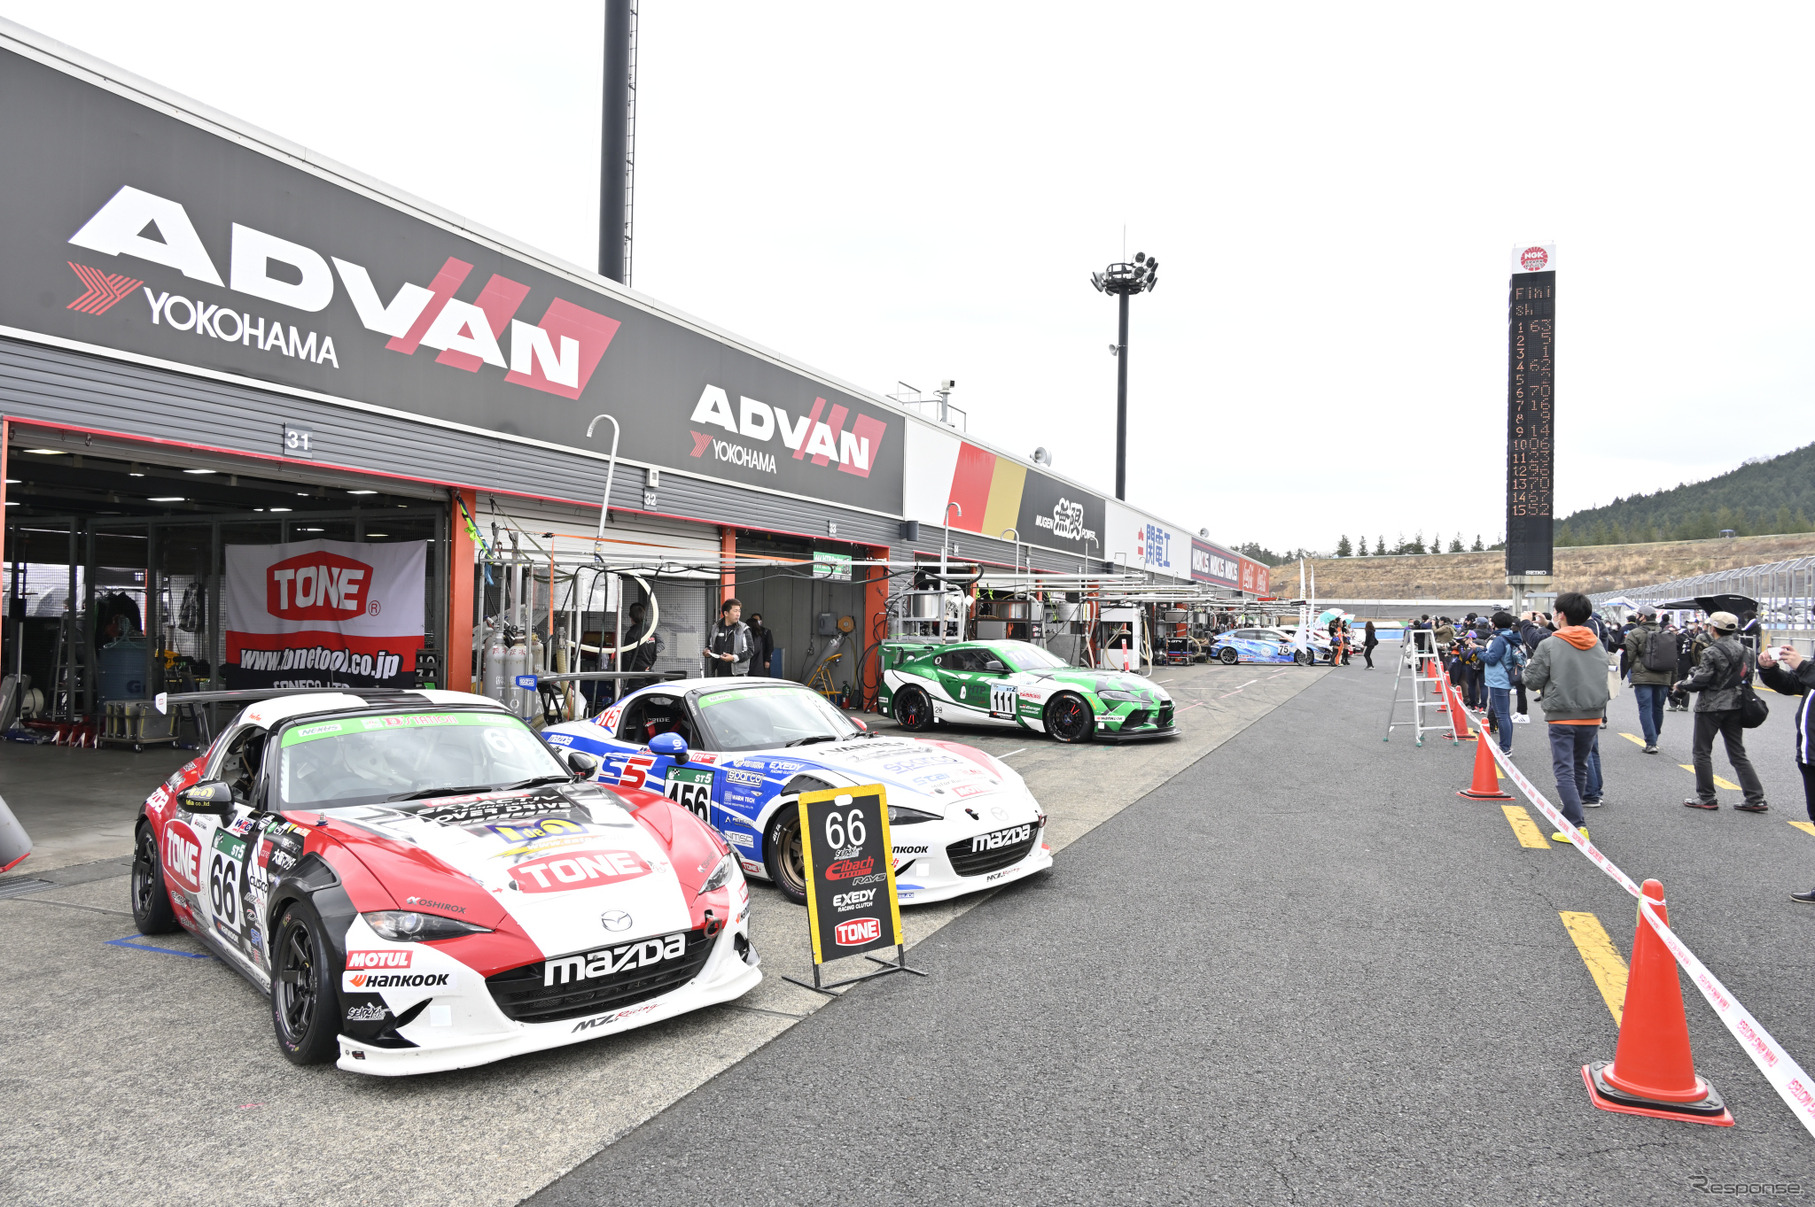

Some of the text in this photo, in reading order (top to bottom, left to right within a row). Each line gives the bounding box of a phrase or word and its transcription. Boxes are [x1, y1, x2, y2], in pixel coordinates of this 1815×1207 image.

[1525, 251, 1543, 259] NGK
[68, 185, 579, 389] ADVAN
[144, 286, 339, 369] YOKOHAMA
[1518, 322, 1524, 333] 1
[1516, 335, 1525, 346] 2
[1516, 348, 1525, 359] 3
[1516, 361, 1524, 372] 4
[1516, 374, 1524, 385] 5
[1516, 388, 1524, 398] 6
[1516, 400, 1524, 411] 7
[1516, 414, 1524, 424] 8
[690, 383, 869, 471] ADVAN
[1516, 426, 1524, 437] 9
[286, 429, 311, 451] 31
[1513, 440, 1527, 450] 10
[712, 437, 777, 475] YOKOHAMA
[1513, 452, 1526, 463] 11
[1513, 465, 1527, 476] 12
[1513, 479, 1527, 489] 13
[644, 493, 657, 506] 32
[1513, 491, 1526, 502] 14
[1513, 503, 1549, 516] 15 52
[1035, 514, 1054, 529] MUGEN
[1054, 498, 1083, 540] 無限
[829, 523, 837, 534] 33
[1146, 523, 1170, 567] 関電工
[274, 565, 365, 611] TONE
[1279, 645, 1289, 654] 75
[994, 691, 1012, 712] 111
[384, 715, 458, 727] D'STATION
[769, 761, 804, 770] EXEDY
[694, 773, 712, 784] ST5
[728, 770, 761, 783] sparco
[417, 795, 560, 815] SKYACTIV
[434, 802, 571, 823] OVER DRIVE
[825, 808, 866, 850] 66
[972, 824, 1031, 853] mazda
[166, 828, 199, 887] TONE
[231, 844, 246, 859] ST5
[518, 852, 643, 889] TONE
[825, 856, 874, 880] Eibach
[852, 872, 887, 886] RAYS
[210, 853, 236, 925] 66
[833, 888, 877, 906] EXEDY
[855, 901, 873, 910] CLUTCH
[838, 921, 878, 942] TONE
[348, 952, 409, 967] MOTUL
[544, 933, 686, 987] mazda
[365, 974, 450, 988] HANKOOK
